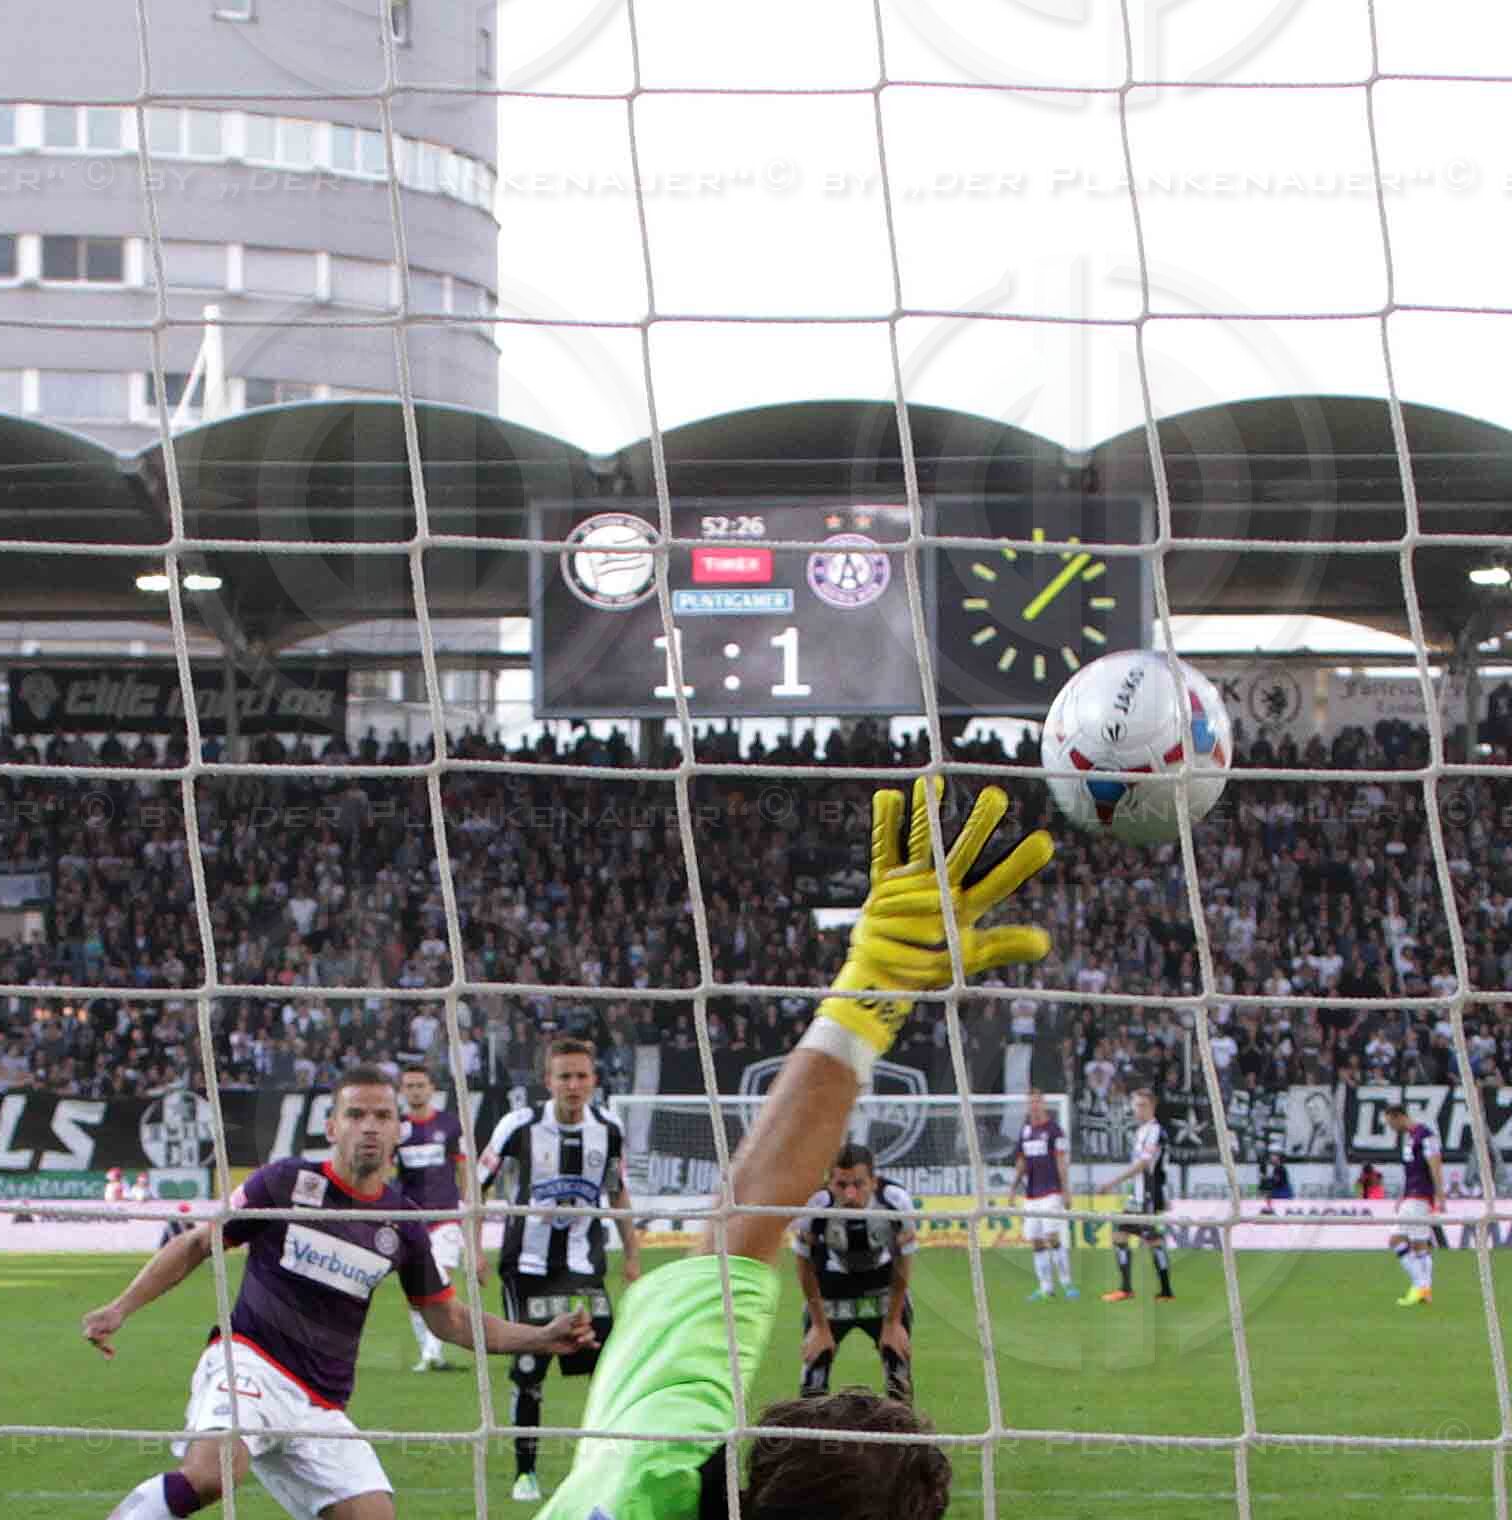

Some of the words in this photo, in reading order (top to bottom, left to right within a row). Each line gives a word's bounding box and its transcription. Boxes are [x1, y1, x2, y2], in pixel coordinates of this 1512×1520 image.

[700, 514, 767, 538] 52:26
[771, 627, 812, 697] 1
[292, 1239, 383, 1288] Verbund
